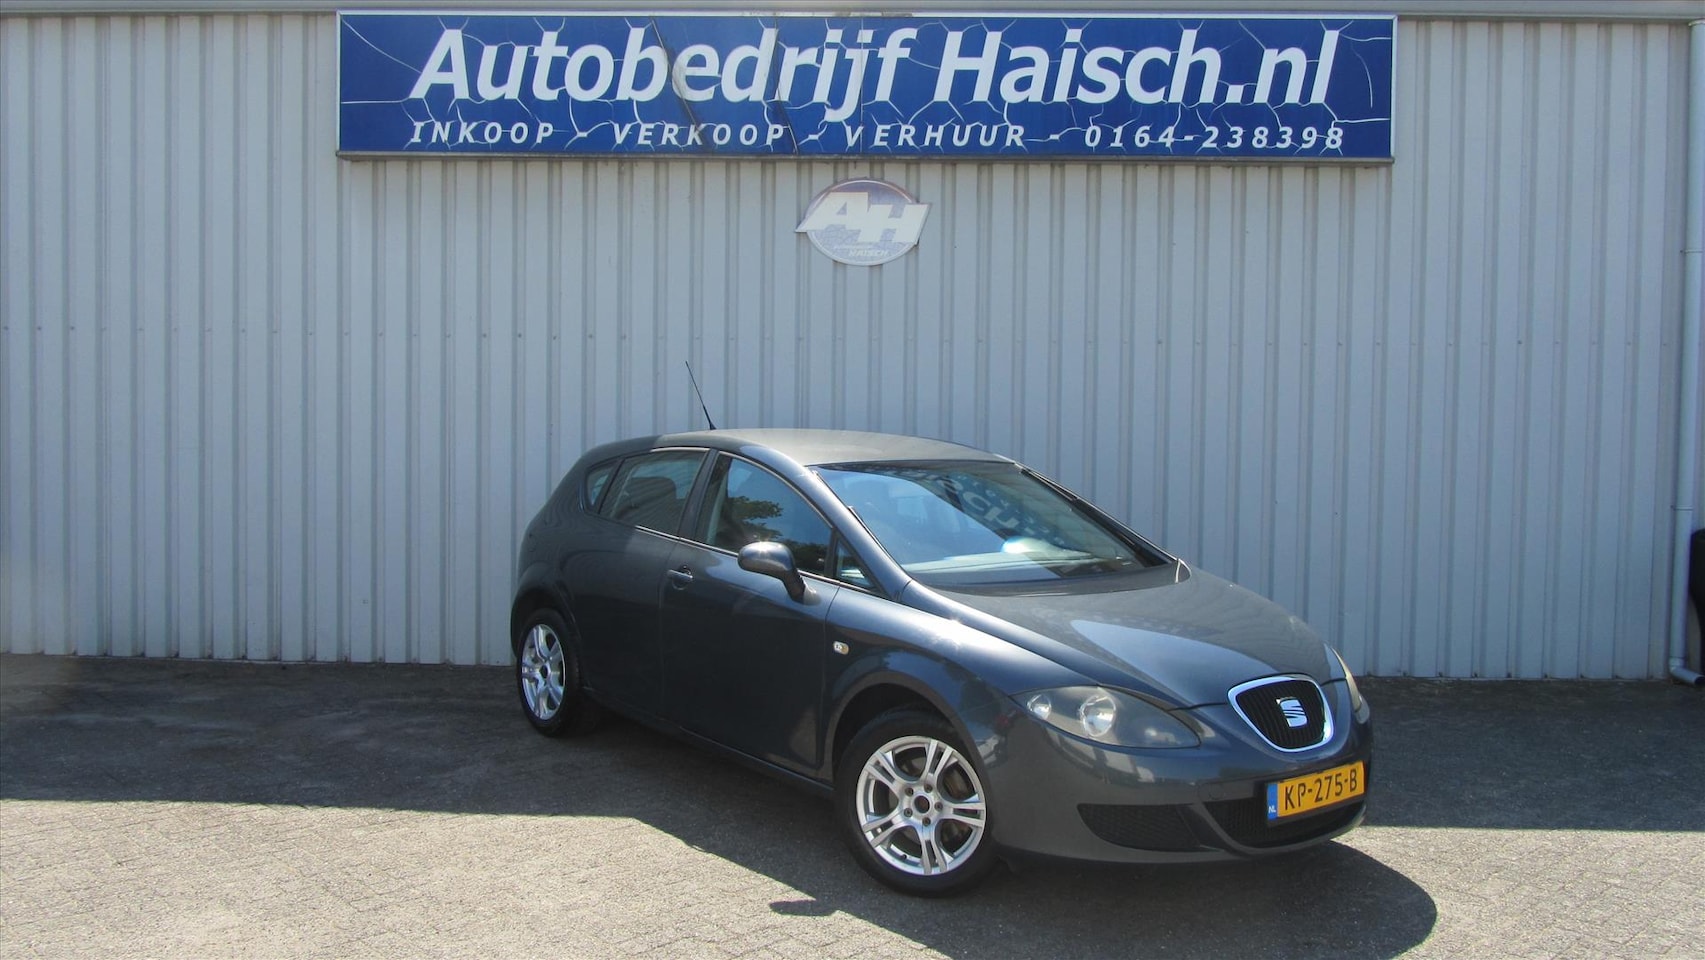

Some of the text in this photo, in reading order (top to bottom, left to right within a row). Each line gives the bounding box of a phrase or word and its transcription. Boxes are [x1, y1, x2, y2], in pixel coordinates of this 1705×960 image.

[407, 27, 1339, 122] Autobedrijf Haisch.nl
[410, 121, 555, 145] INKOOP
[613, 122, 784, 146] VERKOOP
[845, 123, 1025, 148] VERHUUR
[1085, 126, 1344, 150] 0164-238398
[1285, 768, 1357, 811] KP-275-B
[1268, 804, 1277, 814] NL
